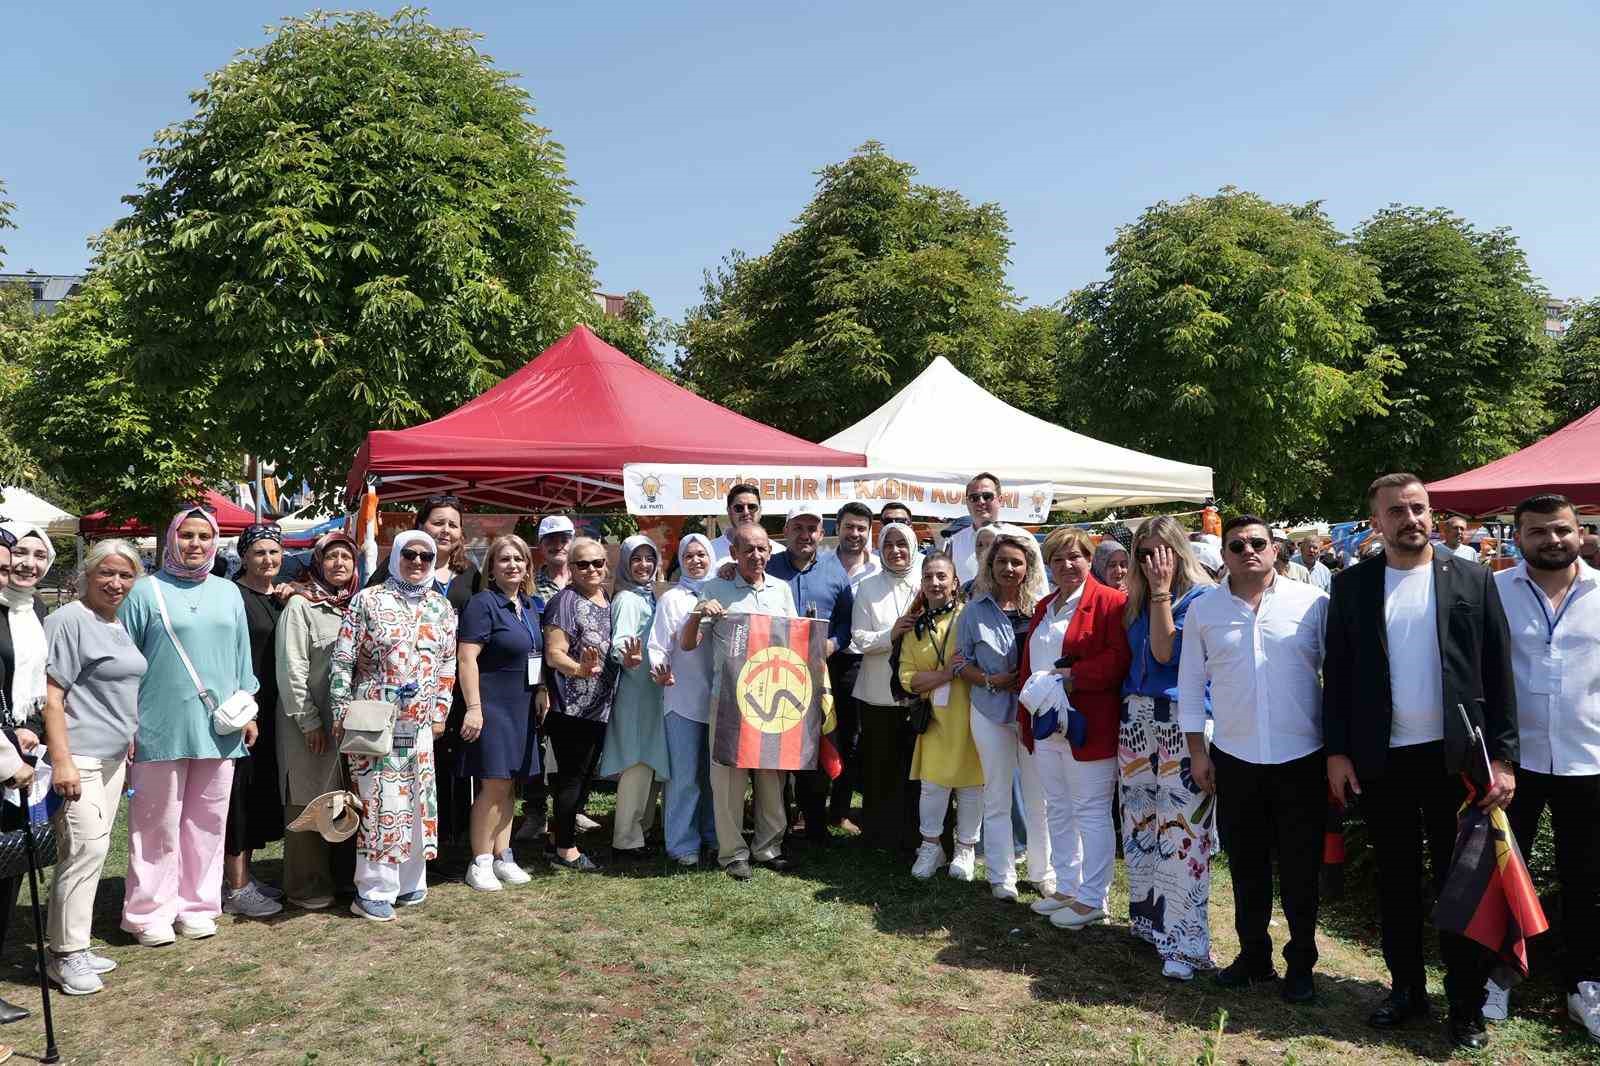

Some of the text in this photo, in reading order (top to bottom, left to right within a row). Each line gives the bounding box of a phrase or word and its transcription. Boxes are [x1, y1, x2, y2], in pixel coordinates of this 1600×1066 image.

[682, 474, 819, 501] ESKEHİR
[826, 474, 848, 500] İL
[854, 479, 924, 502] KADIN
